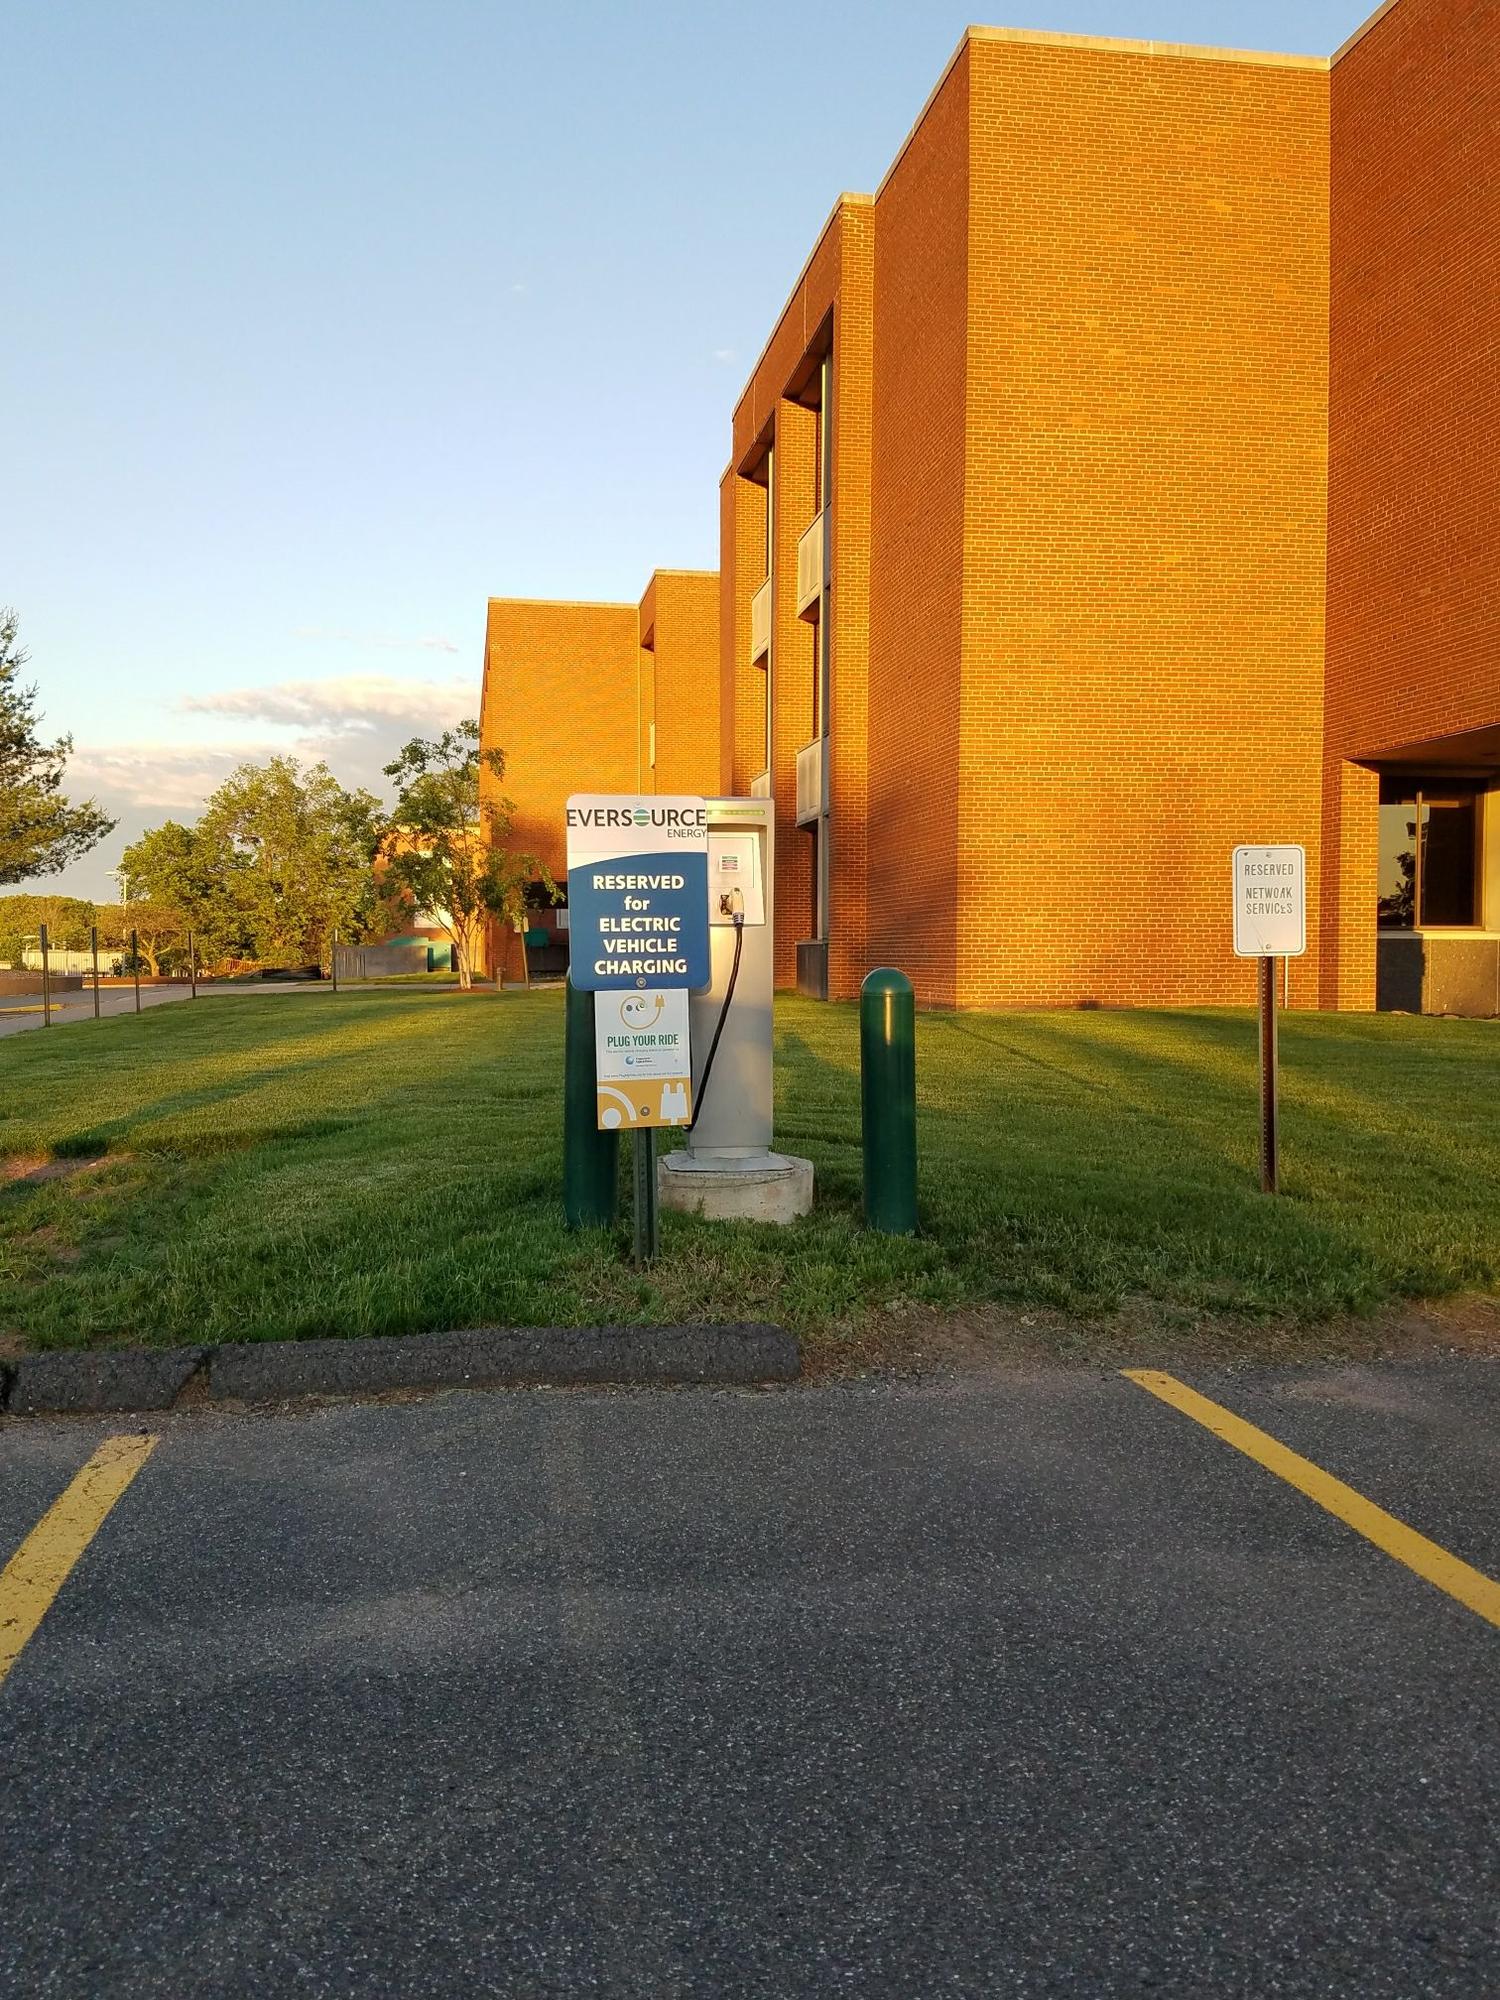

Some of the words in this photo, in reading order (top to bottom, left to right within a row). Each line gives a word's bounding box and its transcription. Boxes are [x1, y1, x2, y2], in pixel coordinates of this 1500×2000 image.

[567, 808, 707, 827] EVERSOURCE
[667, 829, 707, 838] ENERGY
[1244, 864, 1294, 876] RESERVED
[593, 875, 685, 890] RESERVED
[1246, 887, 1293, 899] NETWORK
[624, 896, 650, 911] for
[1246, 903, 1293, 915] SERVICES
[599, 917, 681, 932] ELECTRIC
[603, 939, 677, 953] VEHICLE
[594, 959, 687, 975] CHARGING
[607, 1036, 630, 1047] PLUG
[632, 1034, 656, 1046] YOUR
[658, 1034, 679, 1045] RIDE
